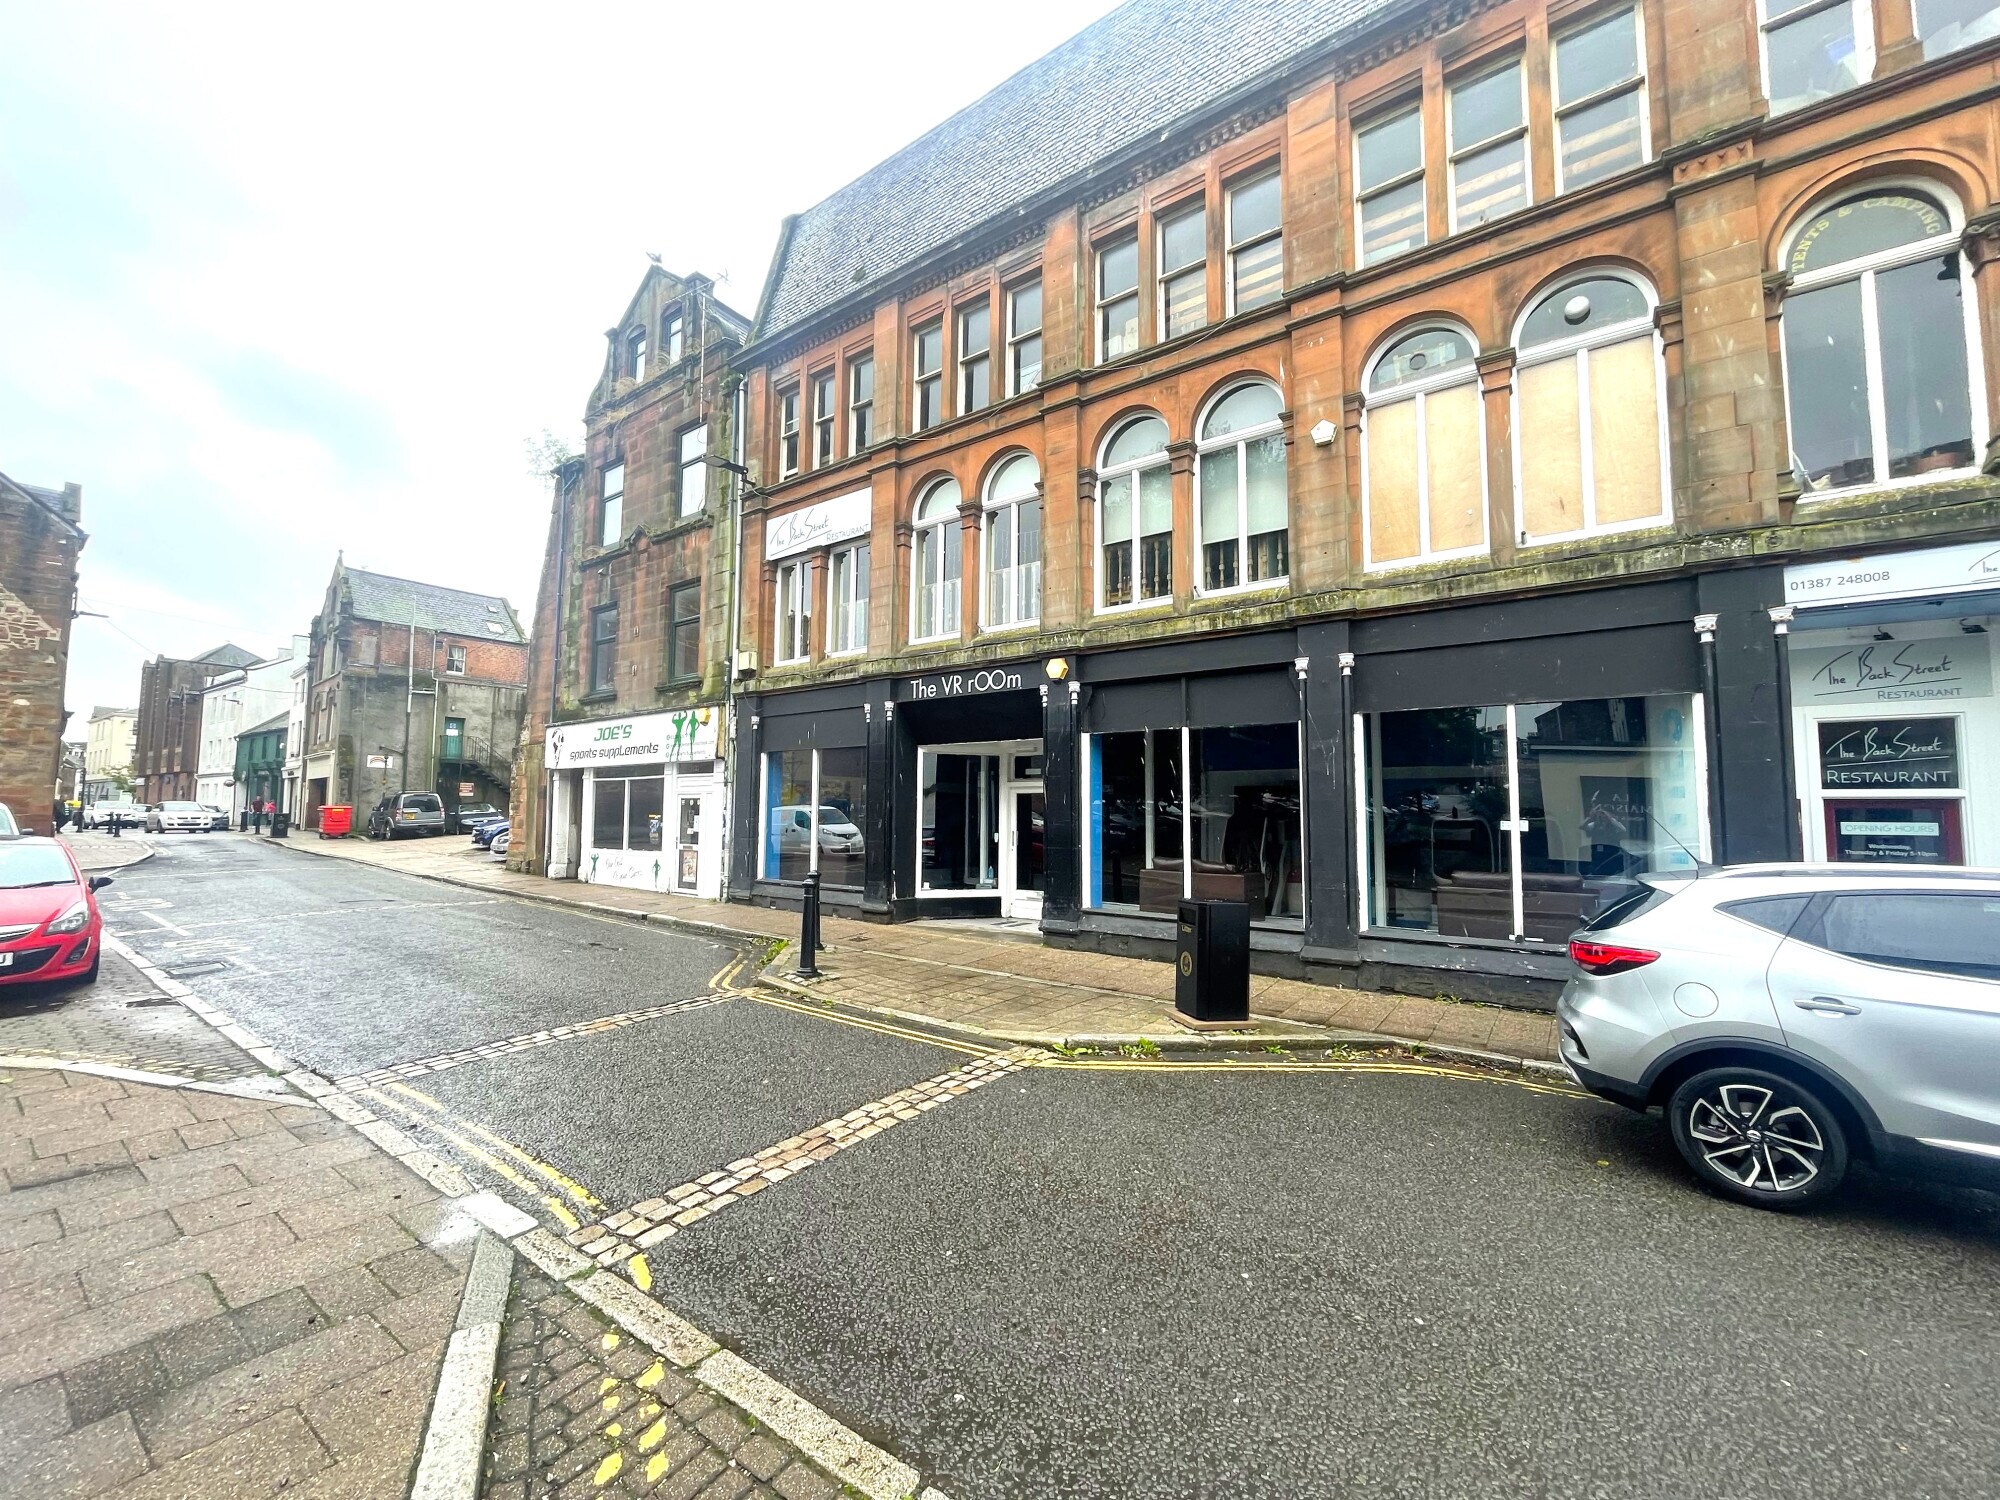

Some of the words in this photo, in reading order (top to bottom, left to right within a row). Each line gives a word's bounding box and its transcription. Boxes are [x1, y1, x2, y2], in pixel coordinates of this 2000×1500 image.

[1791, 219, 1830, 273] TENTS
[1838, 206, 1853, 218] &
[1862, 197, 1941, 234] CAMPING
[788, 513, 805, 544] Back
[805, 508, 829, 539] Street
[826, 523, 869, 542] RESTAURANT
[1790, 578, 1832, 591] 01387
[1837, 571, 1890, 585] 248008
[1812, 650, 1853, 685] The
[1857, 646, 1895, 687] Back
[1893, 643, 1952, 683] Street
[910, 678, 937, 699] The
[941, 675, 963, 695] VR
[1877, 687, 1962, 700] RESTAURANT
[594, 724, 632, 741] JOE'S
[1826, 730, 1860, 757] The
[1863, 726, 1895, 761] Back
[1893, 726, 1942, 759] Street
[1826, 770, 1951, 783] RESTAURANT
[1844, 824, 1891, 833] OPENING
[1895, 825, 1935, 833] HOURS
[1845, 849, 1877, 857] Thursday
